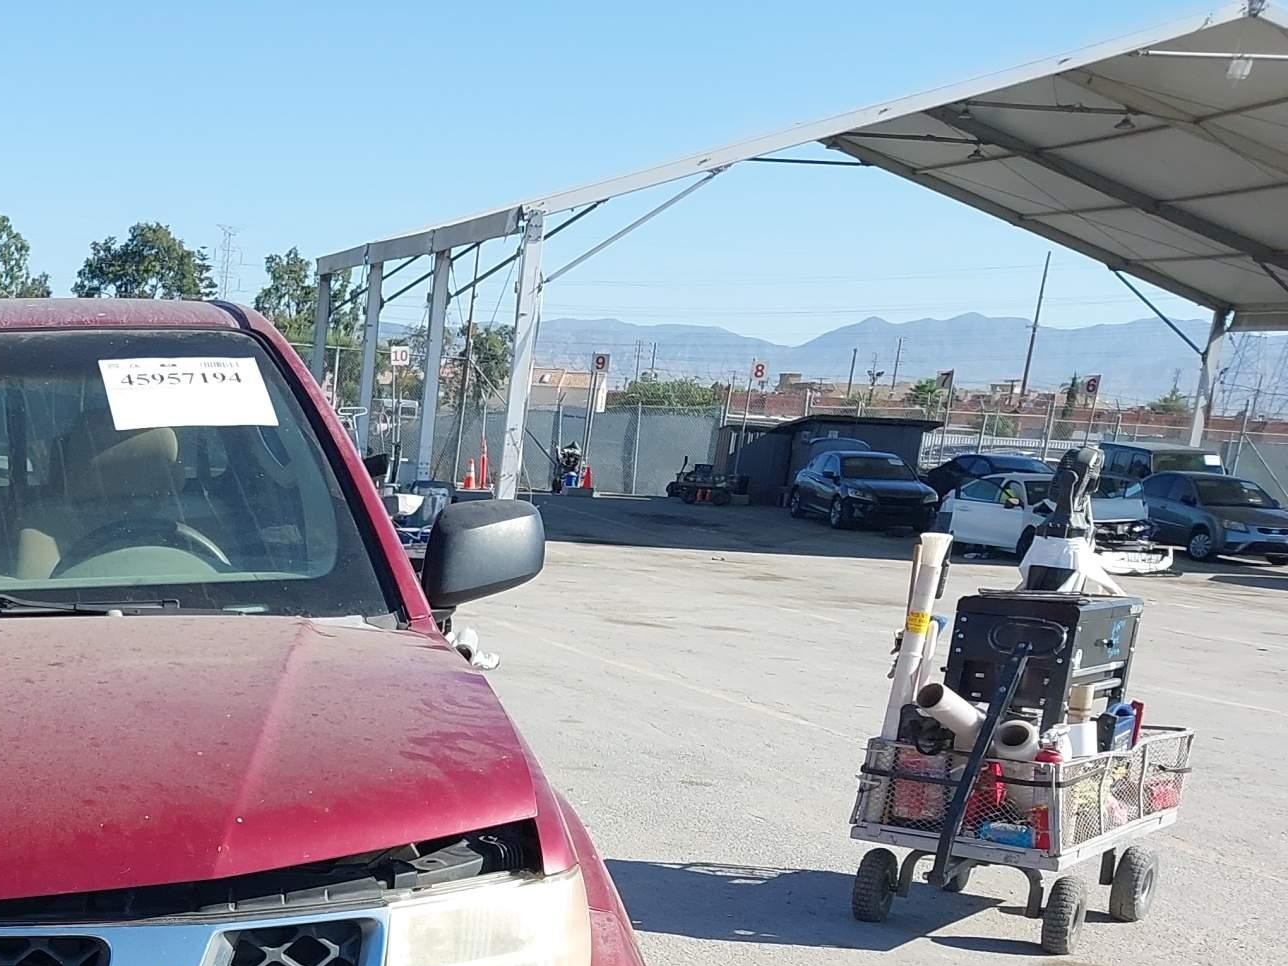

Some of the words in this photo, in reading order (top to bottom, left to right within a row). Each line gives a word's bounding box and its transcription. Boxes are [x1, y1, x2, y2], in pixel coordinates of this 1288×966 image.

[392, 351, 408, 362] 10
[596, 355, 605, 370] 9
[754, 363, 765, 378] 8
[120, 371, 242, 386] 45957194
[941, 372, 952, 388] 7
[1086, 378, 1097, 393] 6
